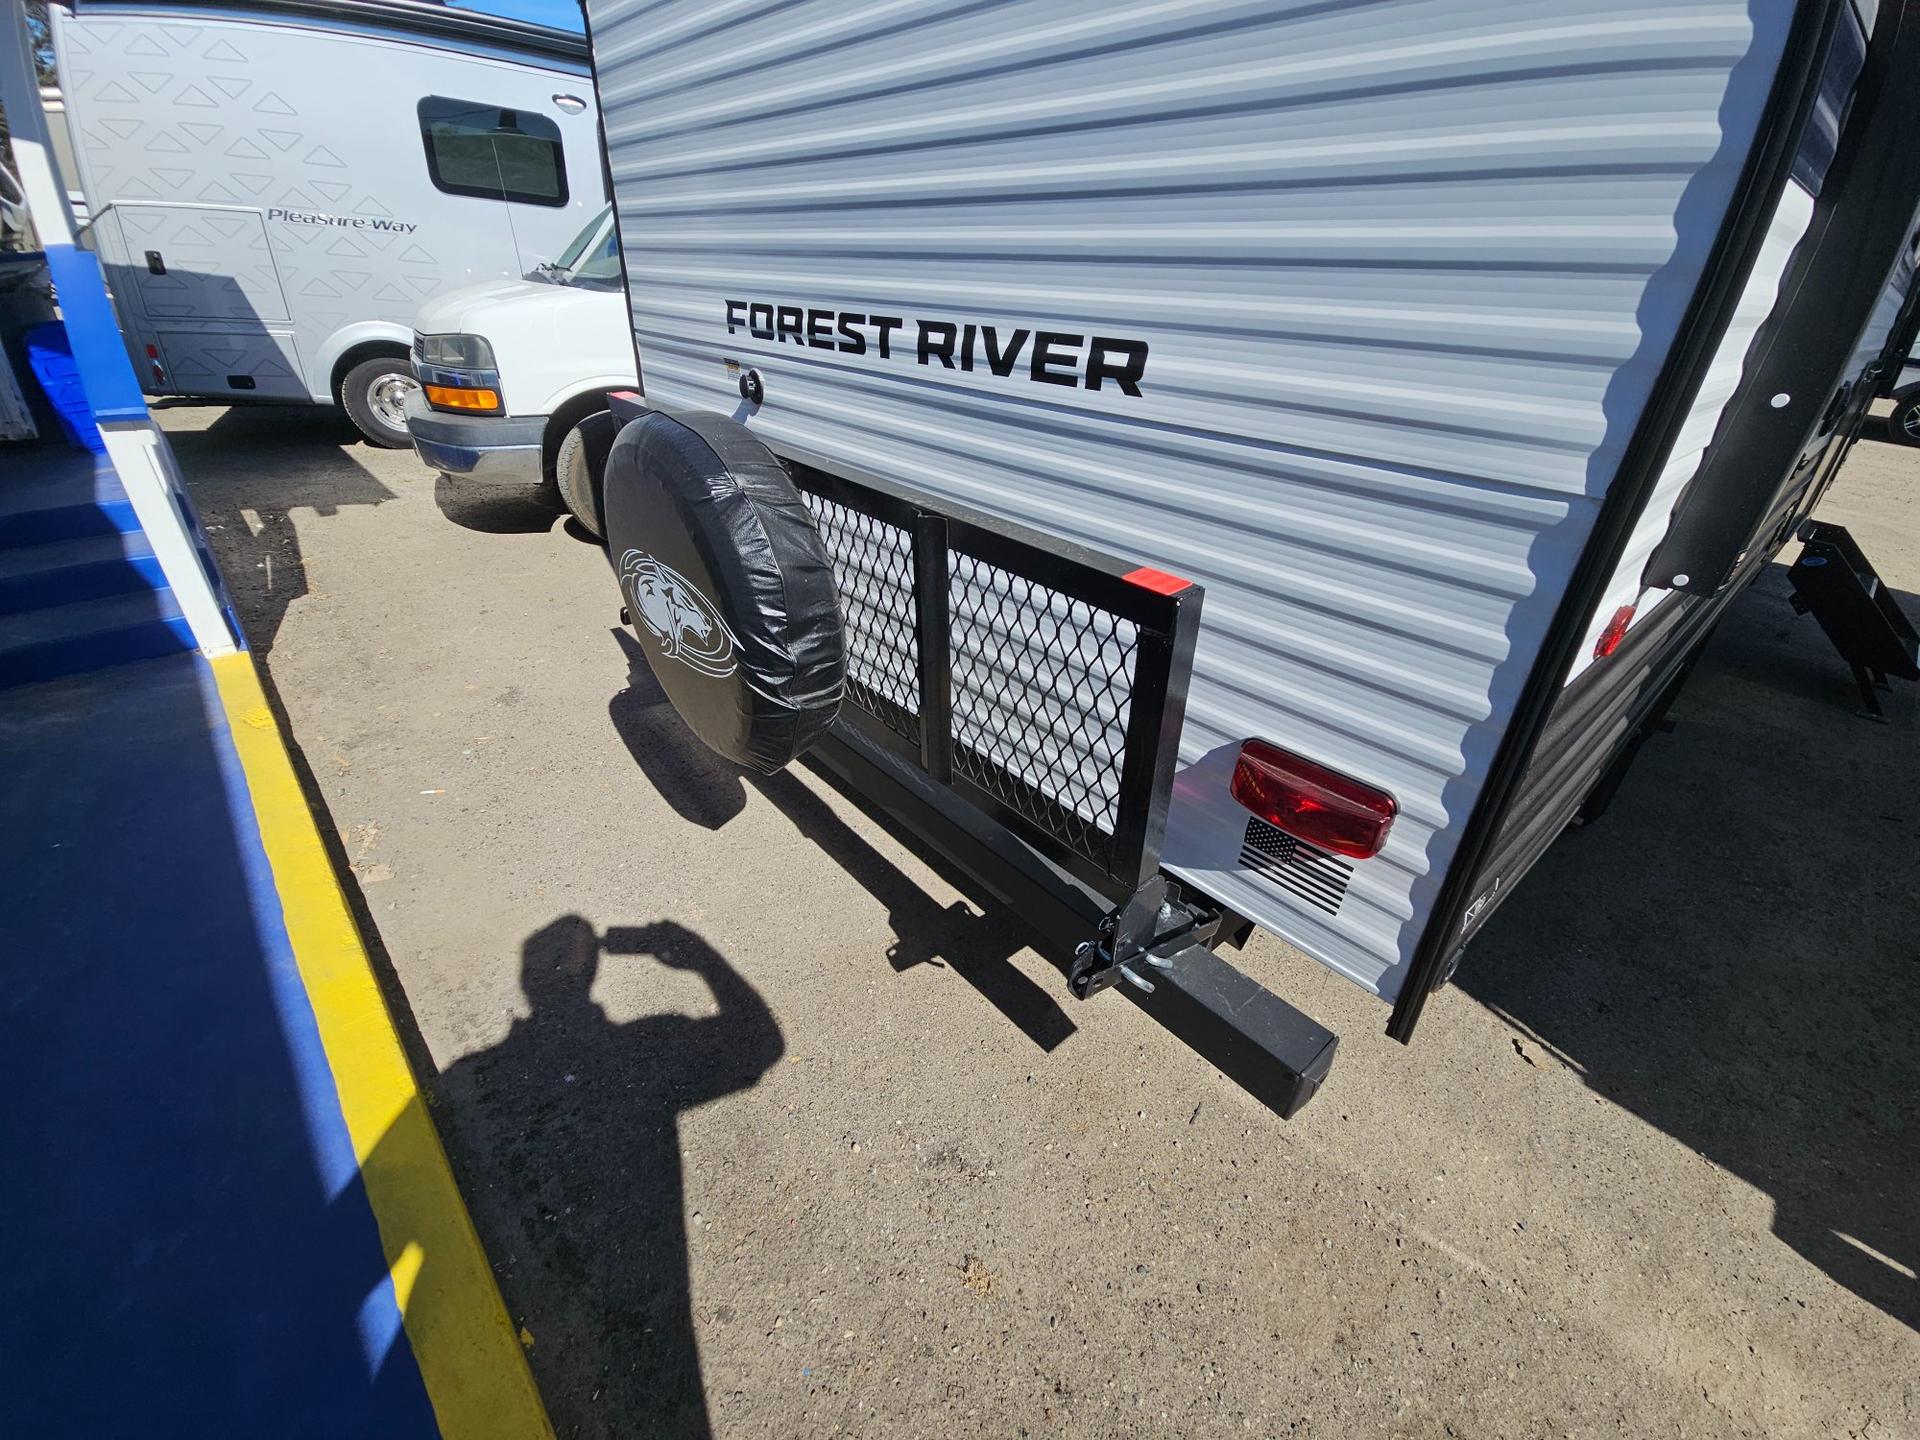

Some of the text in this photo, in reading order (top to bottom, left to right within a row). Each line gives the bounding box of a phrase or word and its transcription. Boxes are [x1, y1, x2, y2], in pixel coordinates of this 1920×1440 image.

[268, 208, 417, 235] Pleasure-Way
[725, 299, 1149, 398] FOREST RIVER
